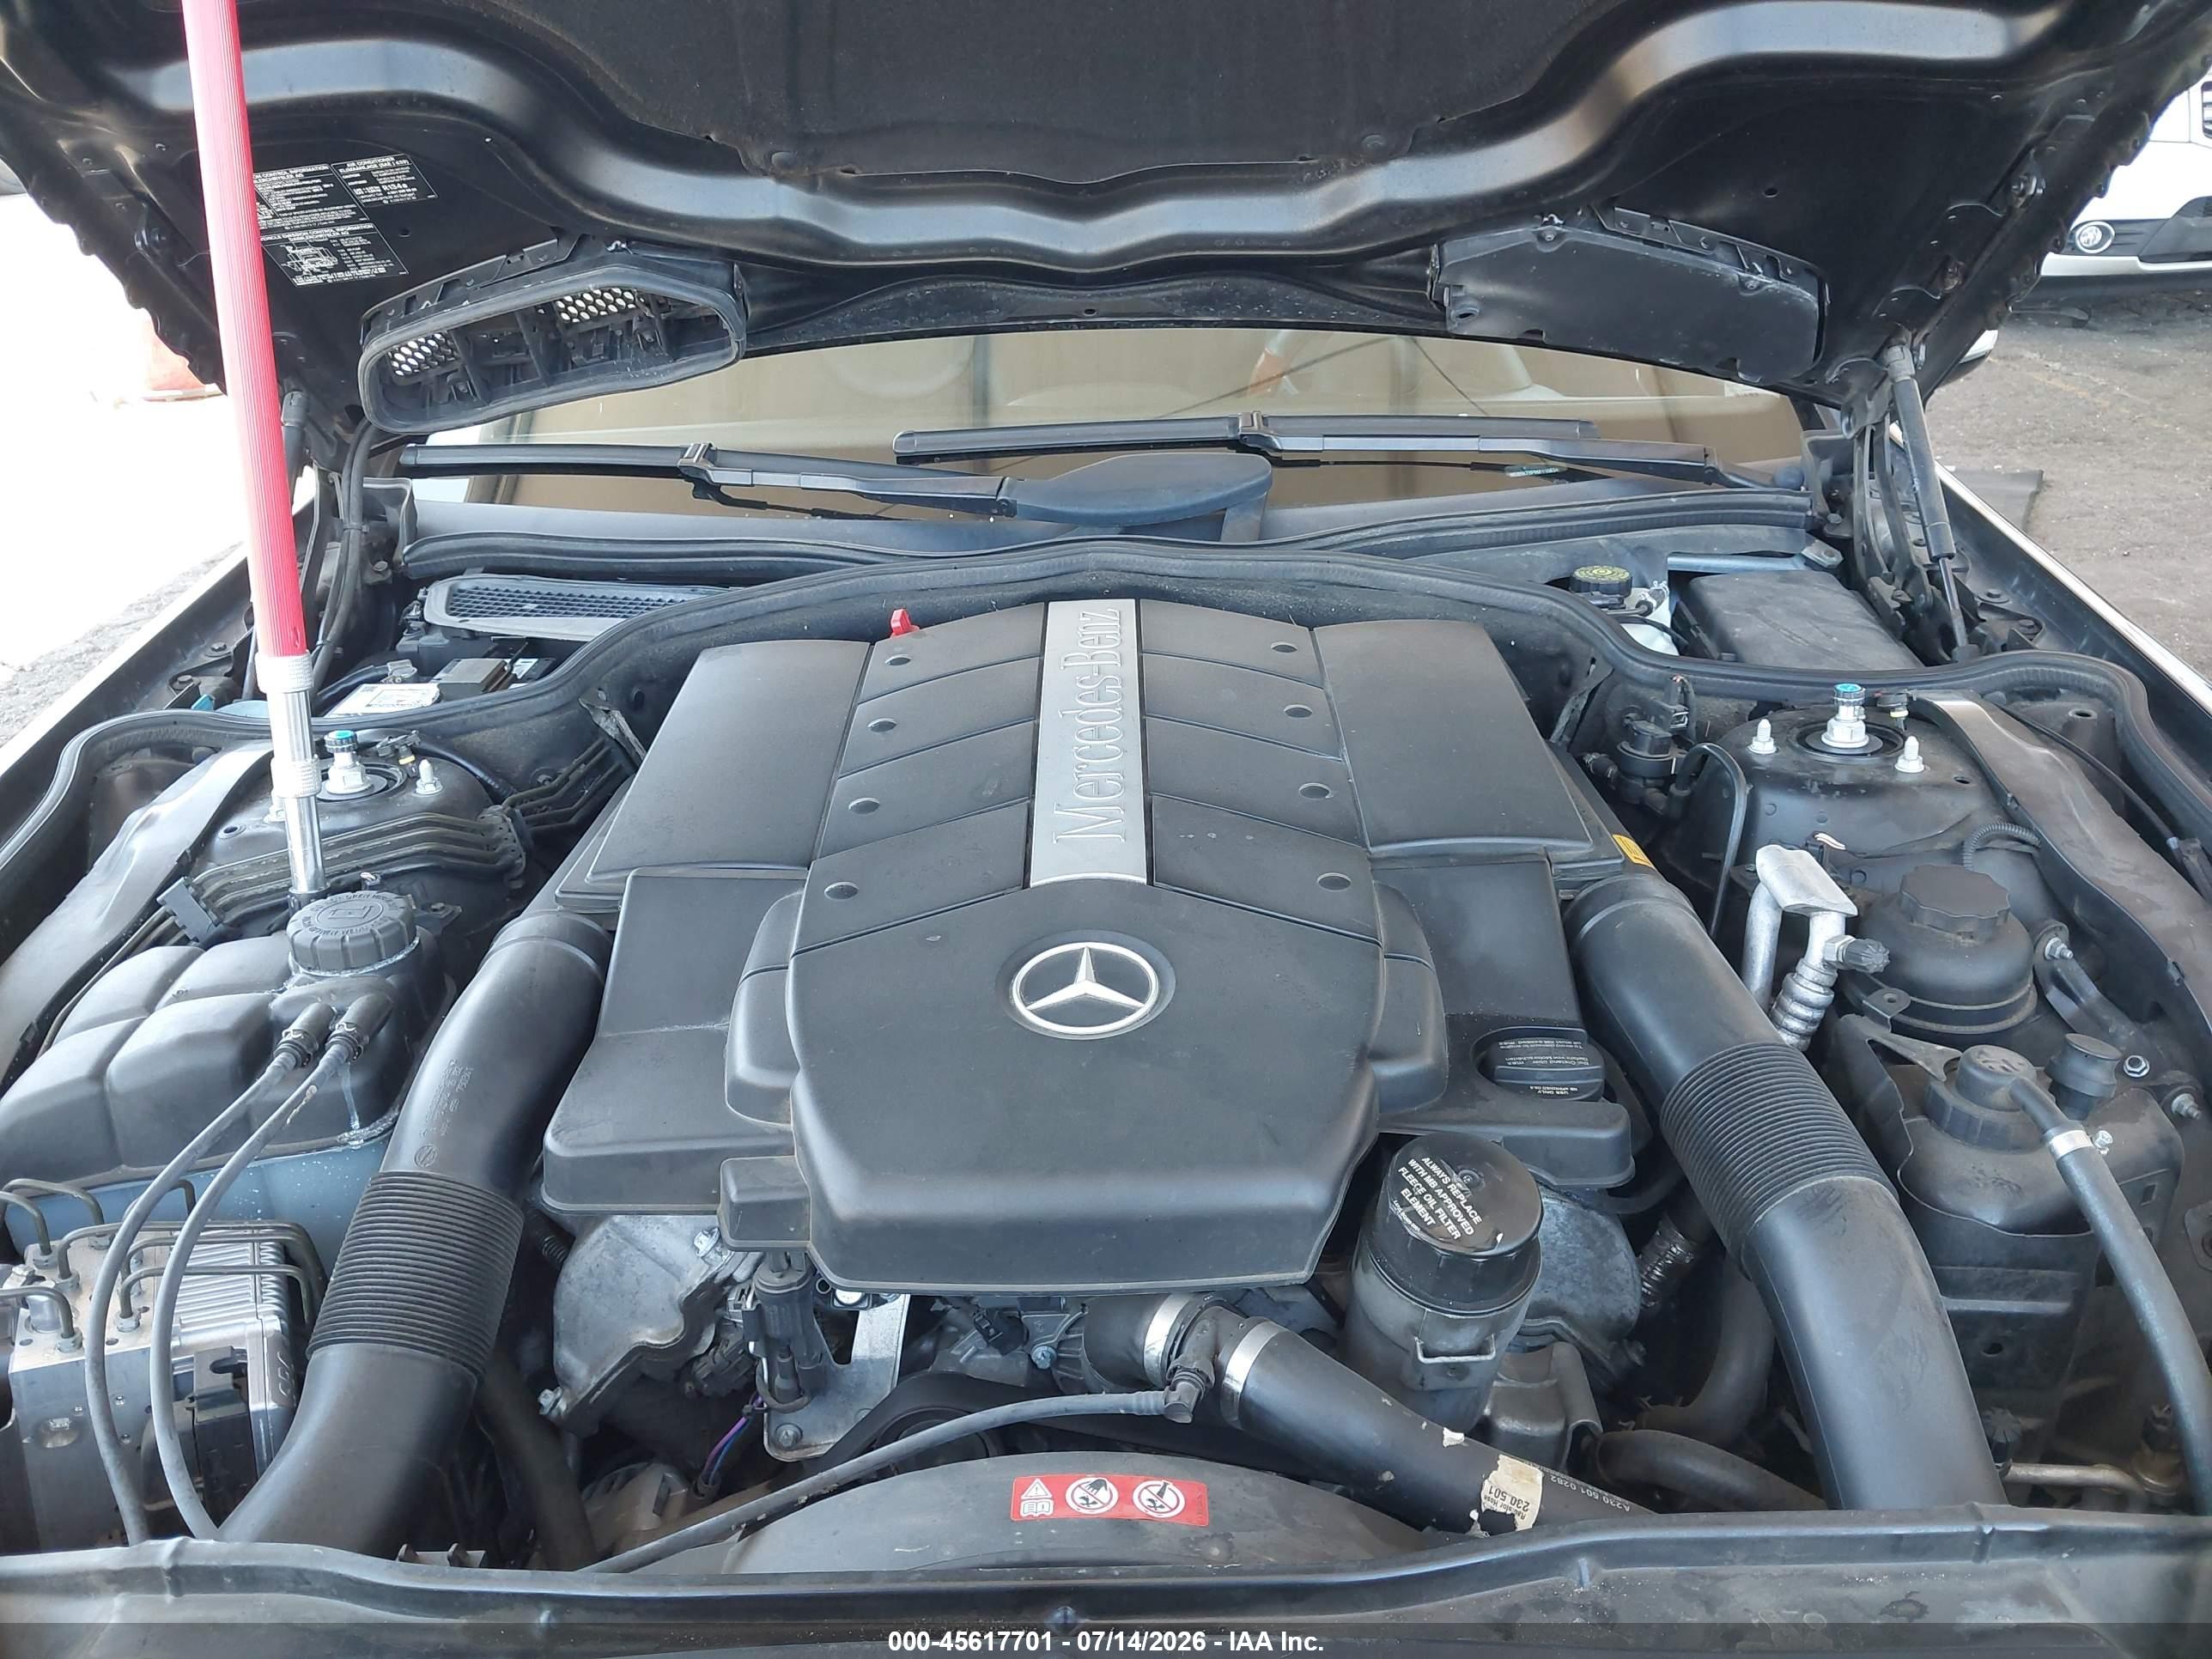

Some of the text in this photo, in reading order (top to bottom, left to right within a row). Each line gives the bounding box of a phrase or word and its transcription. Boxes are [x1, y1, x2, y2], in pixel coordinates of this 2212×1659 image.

[1052, 607, 1126, 845] Mercedes-Benz
[1397, 1166, 1427, 1195] FLEECE
[1423, 1194, 1437, 1210] OIL
[1434, 1207, 1462, 1240] FILTER
[1401, 1188, 1437, 1226] ELEMENT
[1407, 1158, 1474, 1236] WITH MB APPROVED
[1421, 1157, 1483, 1224] ALWAYS REPLACE
[1488, 1485, 1531, 1512] 230 501
[1580, 1486, 1601, 1501] 501
[1602, 1495, 1631, 1512] A230
